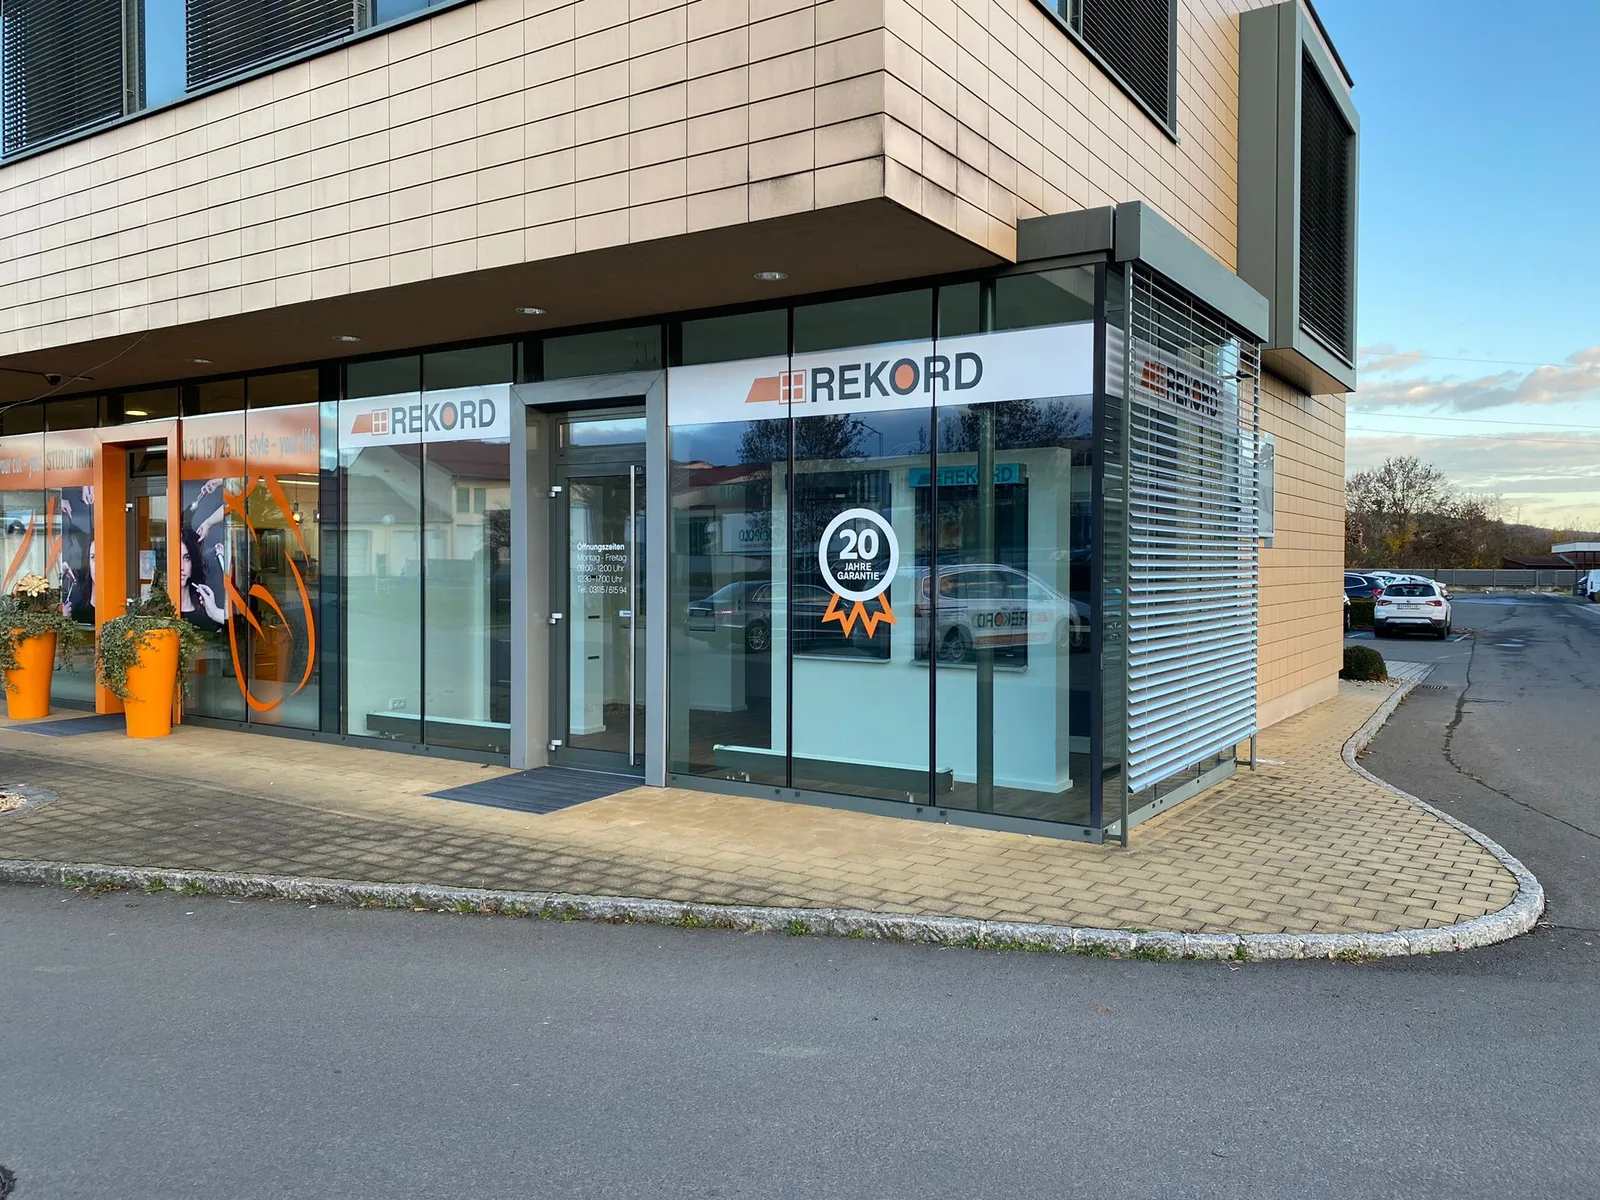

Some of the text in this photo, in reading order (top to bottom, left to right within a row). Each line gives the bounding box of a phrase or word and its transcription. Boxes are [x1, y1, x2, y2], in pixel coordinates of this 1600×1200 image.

[811, 351, 984, 403] REKORD
[391, 398, 496, 435] REKORD
[189, 438, 199, 460] 31
[202, 436, 213, 459] 15
[220, 435, 231, 459] 25
[233, 433, 244, 457] 10
[249, 433, 269, 463] style
[302, 427, 316, 453] life
[46, 449, 74, 471] STUDIO
[943, 466, 1013, 485] REKRD
[576, 541, 625, 553] Öffnungszeiten
[839, 528, 879, 560] 20
[576, 554, 600, 564] Montag
[605, 553, 627, 564] Freitag
[613, 564, 625, 572] Uhr
[844, 562, 872, 571] JAHRE
[611, 575, 623, 583] Uhr
[836, 571, 880, 581] GARANTIE
